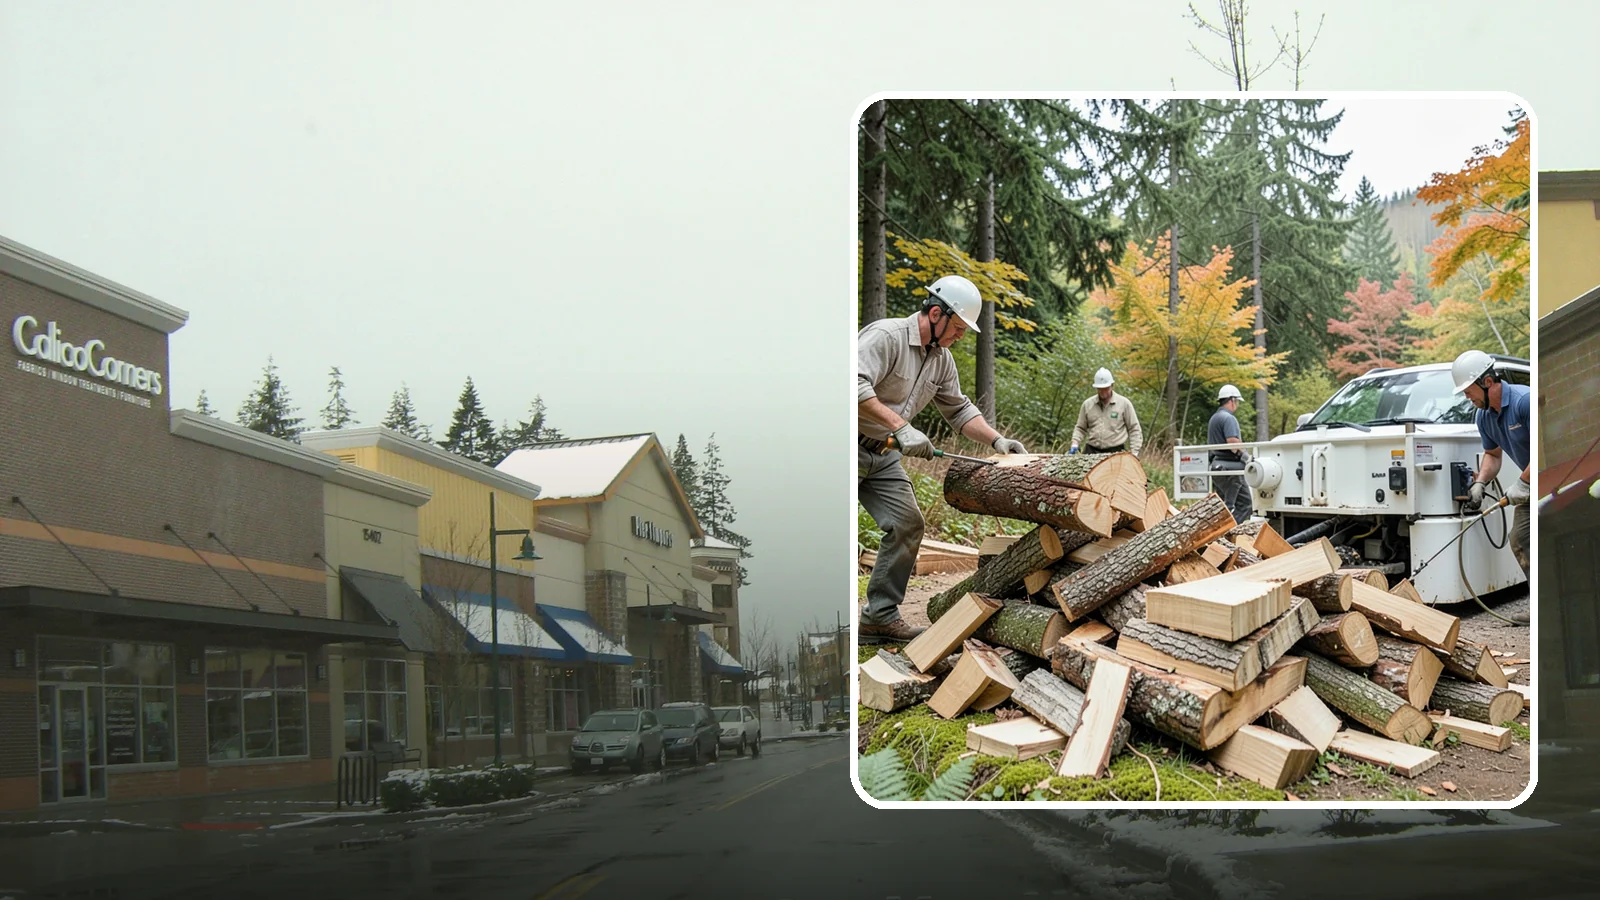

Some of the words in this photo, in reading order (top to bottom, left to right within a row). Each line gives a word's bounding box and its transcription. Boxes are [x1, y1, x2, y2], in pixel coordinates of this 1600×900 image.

[16, 359, 47, 377] FABRICS
[51, 370, 78, 386] WINDOW
[78, 378, 116, 398] TREATMENTS
